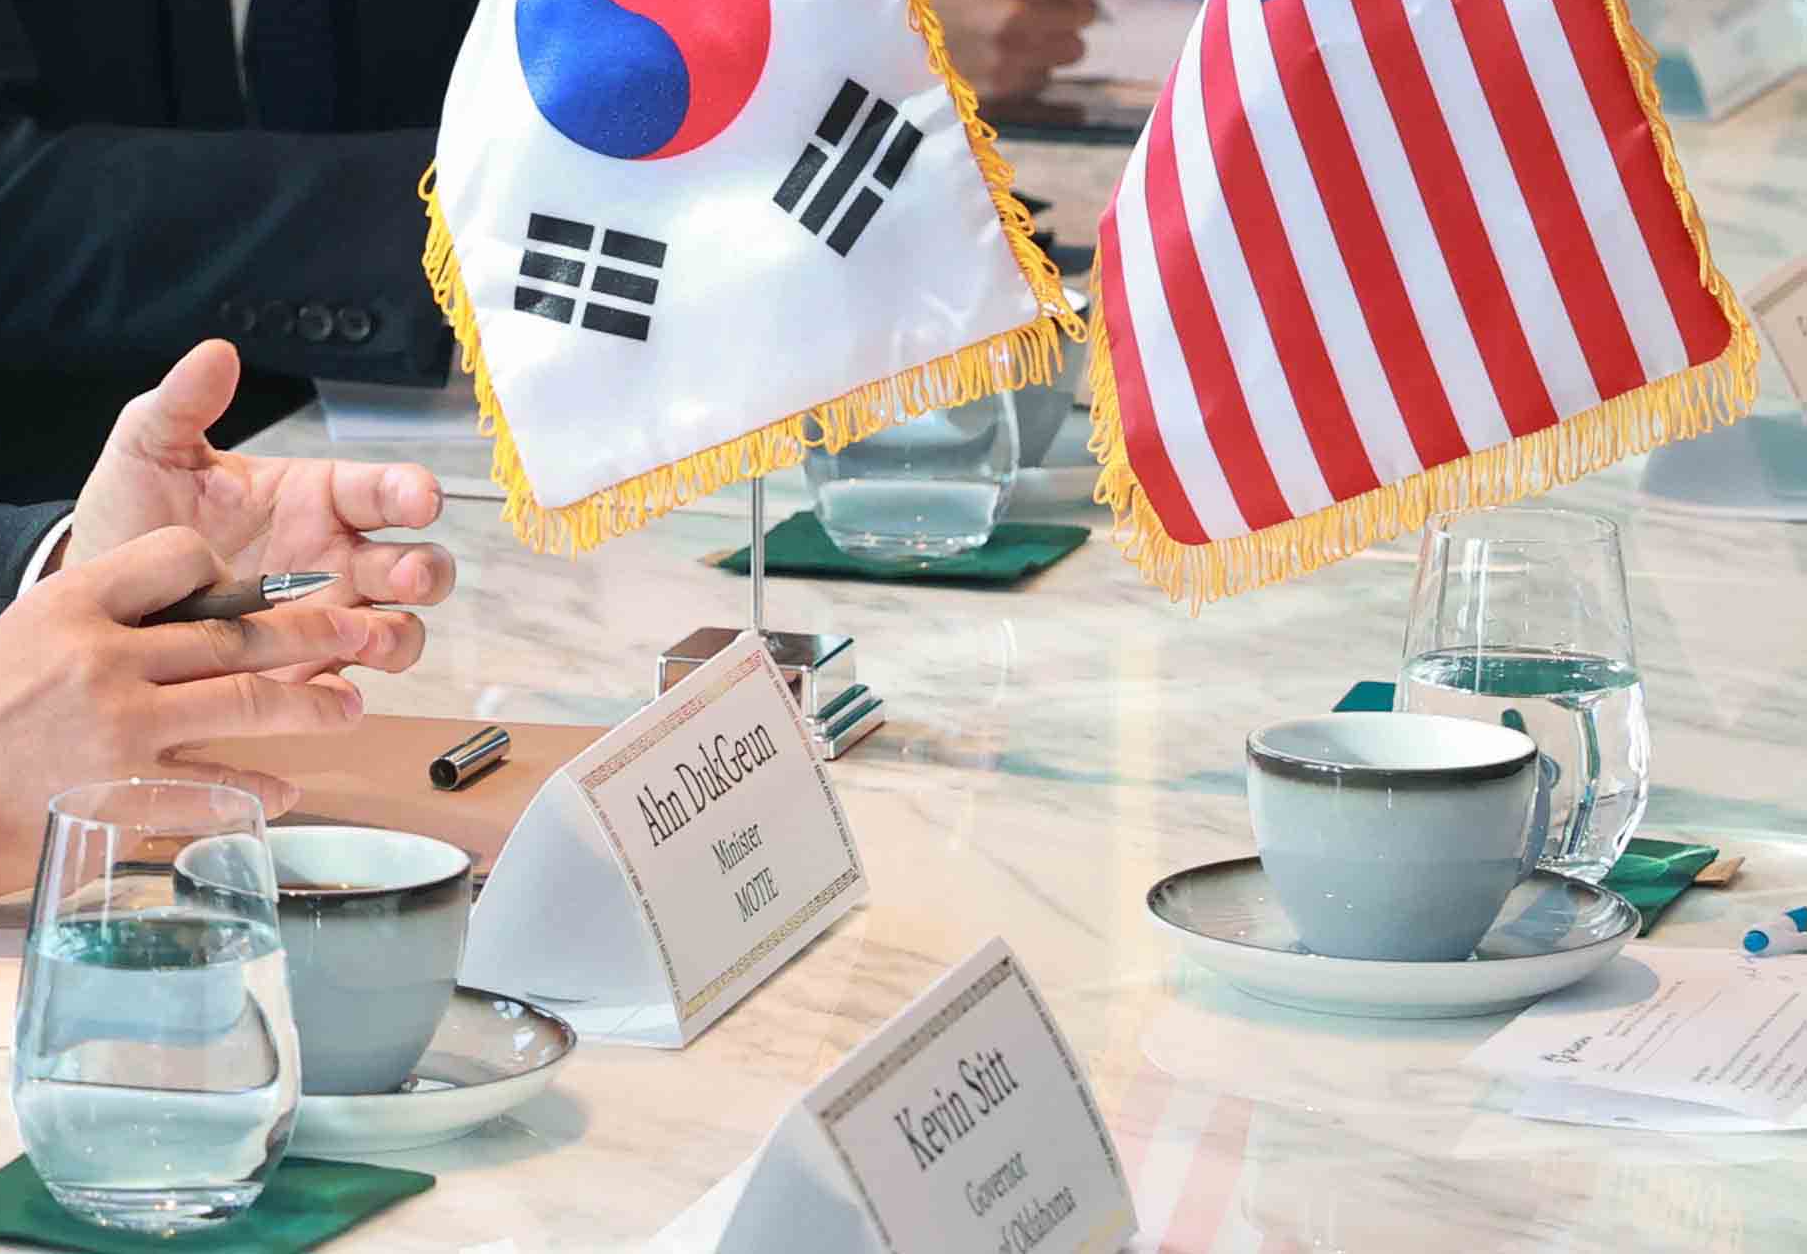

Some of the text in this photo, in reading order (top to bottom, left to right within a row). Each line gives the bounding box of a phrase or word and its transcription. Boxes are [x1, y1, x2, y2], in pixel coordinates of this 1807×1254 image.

[636, 723, 778, 847] Ahn DukGeun
[711, 824, 764, 875] Minister
[734, 866, 780, 923] MOTIE
[894, 1048, 1019, 1171] Kevin Stitt
